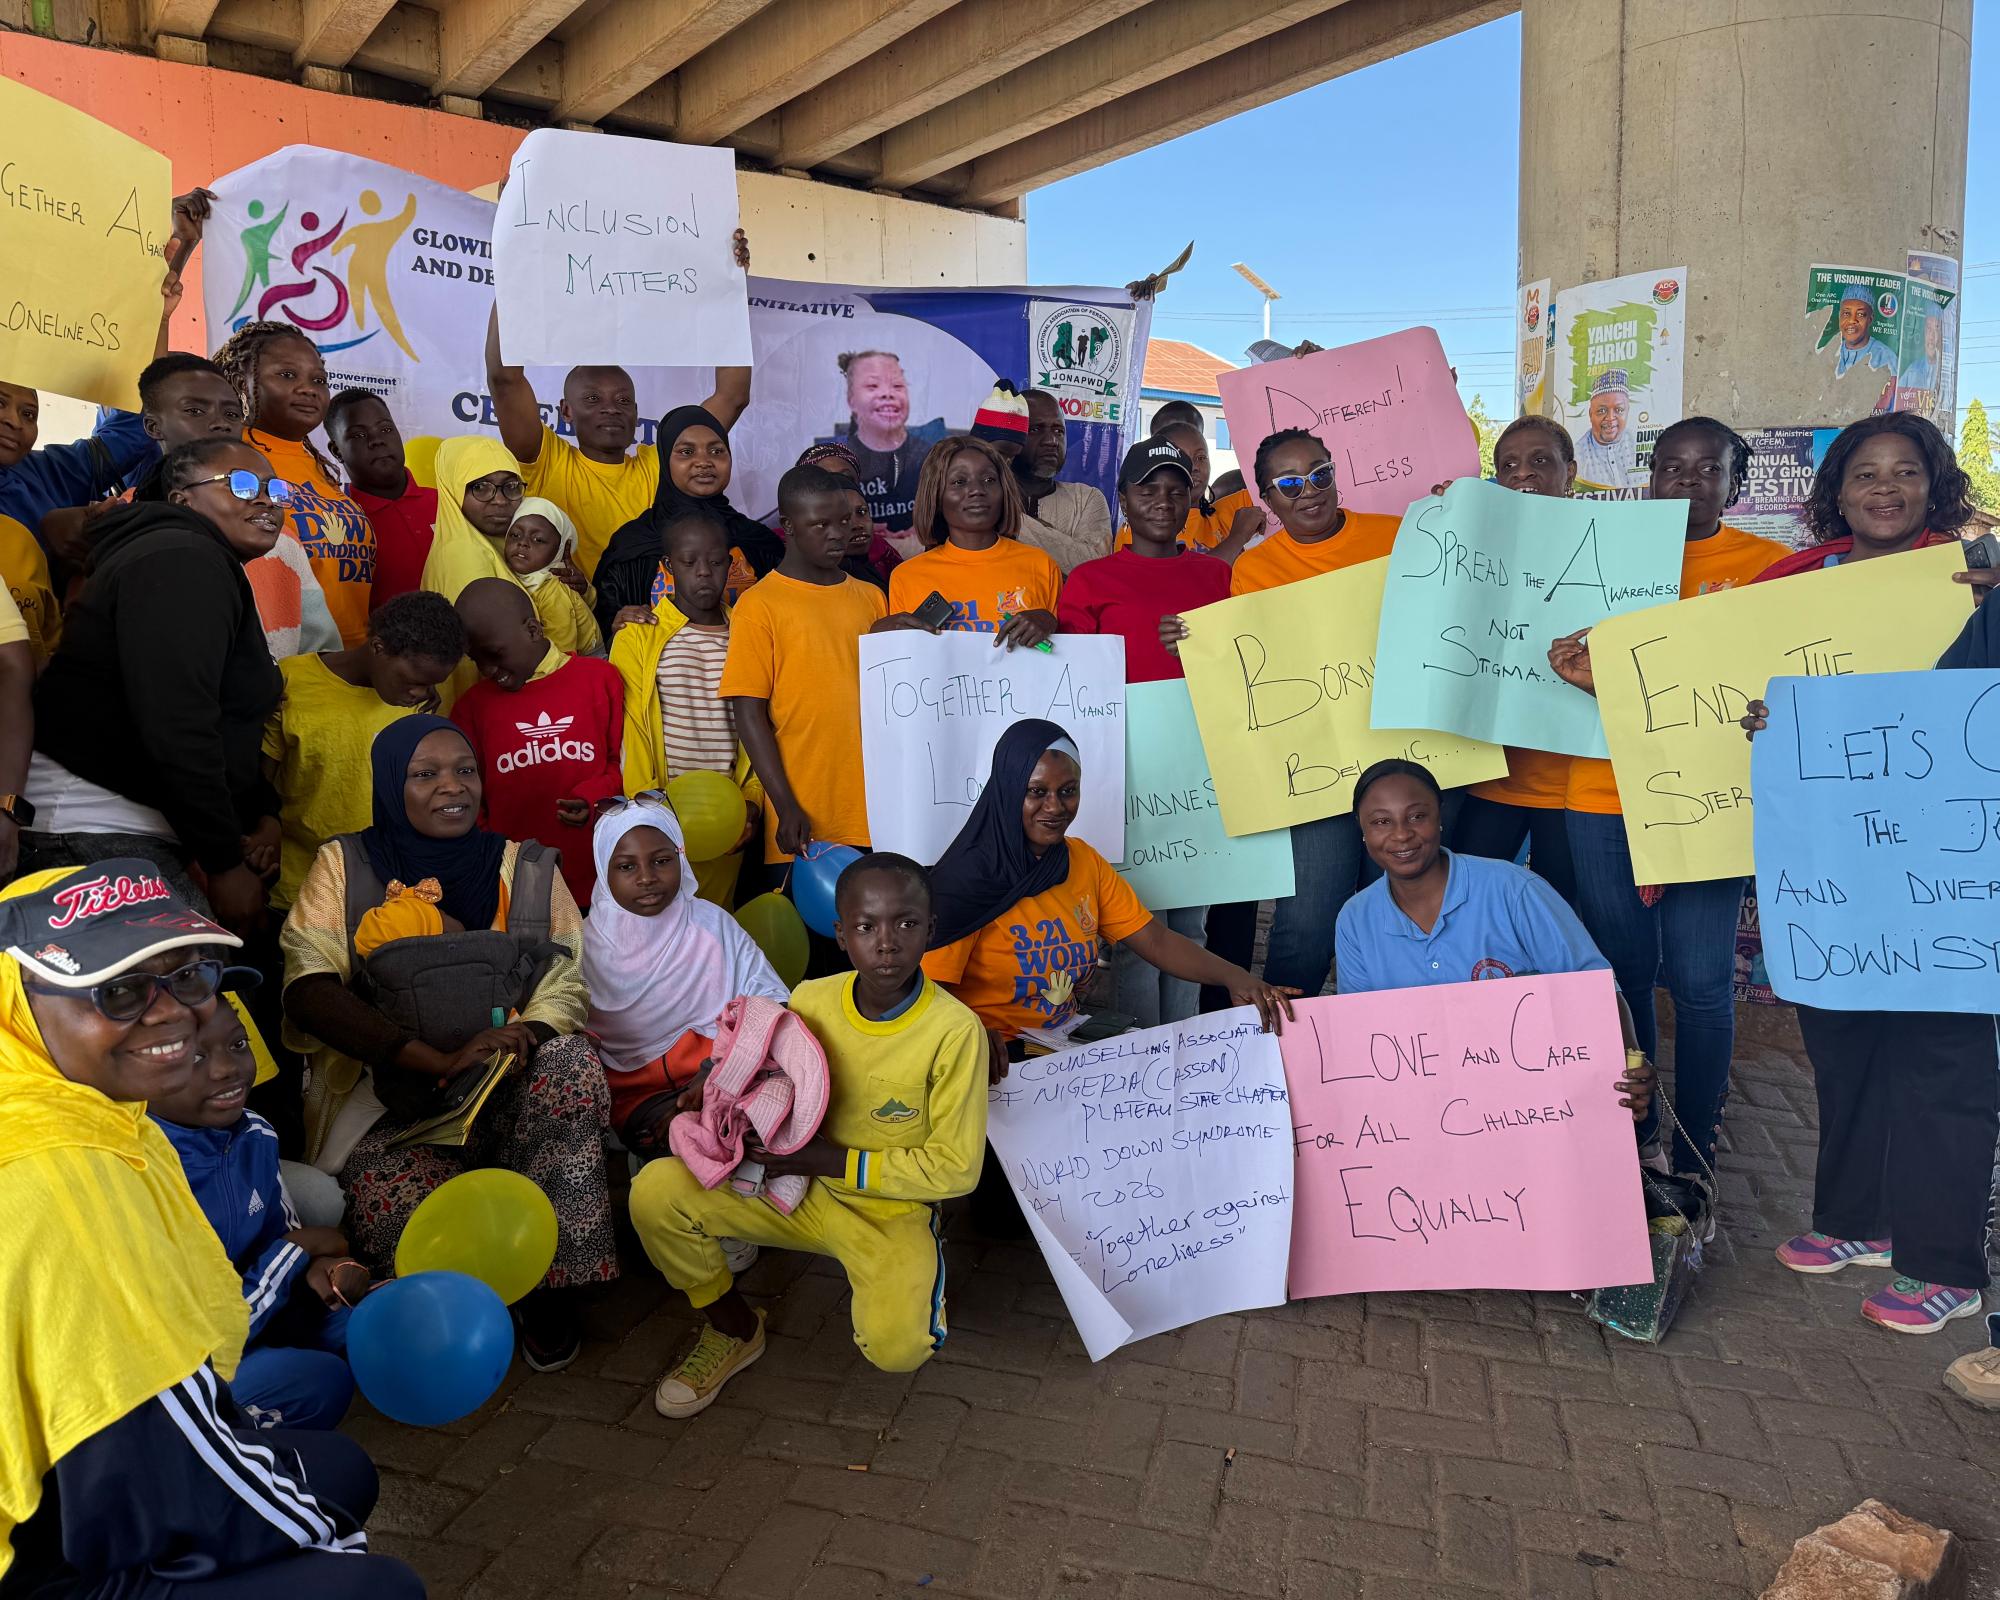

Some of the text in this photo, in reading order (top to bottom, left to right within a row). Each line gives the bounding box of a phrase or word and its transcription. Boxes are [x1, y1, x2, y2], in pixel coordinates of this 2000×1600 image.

[1, 162, 86, 226] GETHER
[514, 160, 699, 238] INCLUSION
[412, 227, 493, 260] GLOWI
[411, 255, 463, 280] AND
[565, 253, 697, 295] MATTERS
[1658, 282, 1675, 291] ADC
[1816, 272, 1901, 290] THE VISIONARY LEADER
[748, 297, 855, 319] INITIATIVE
[1039, 324, 1051, 348] NATIONAL
[1050, 308, 1080, 325] ASSOCIATION
[1088, 310, 1111, 327] PERSONS
[1109, 326, 1119, 339] WITH
[1588, 320, 1638, 344] YANCHI
[1872, 326, 1882, 334] WE
[1587, 339, 1638, 366] FARKO
[326, 371, 397, 386] powerment
[1052, 373, 1104, 388] JONAPWD
[1265, 364, 1405, 434] DIFFERENT!
[1148, 446, 1178, 458] PUMA
[1755, 438, 1785, 447] (CFEM)
[1774, 429, 1813, 437] Ministries
[1346, 448, 1414, 487] LESS
[1755, 496, 1790, 504] BREAKING
[1755, 503, 1788, 512] RECORDS
[1401, 505, 1680, 612] SPREAD THE AWARENESS
[1488, 618, 1530, 641] NOT
[867, 656, 1123, 726] TOGETHER AGAINST
[1630, 635, 1753, 733] END
[1792, 684, 1934, 781] LET'S
[496, 736, 595, 774] adidas
[1853, 810, 1908, 848] THE
[1775, 869, 1848, 907] AND
[1009, 917, 1072, 951] 3.21
[1787, 922, 1922, 982] DOWN
[1309, 992, 1591, 1084] LOVE AND CARE
[1081, 1100, 1172, 1144] PLATEAU
[1292, 1098, 1575, 1158] FOR ALL CHILDREN
[1103, 1138, 1163, 1171] DOWN
[1171, 1125, 1281, 1158] SYNDROME
[1081, 1168, 1165, 1208] 2026
[1203, 1184, 1292, 1227] against
[1339, 1165, 1526, 1245] EQUALLY
